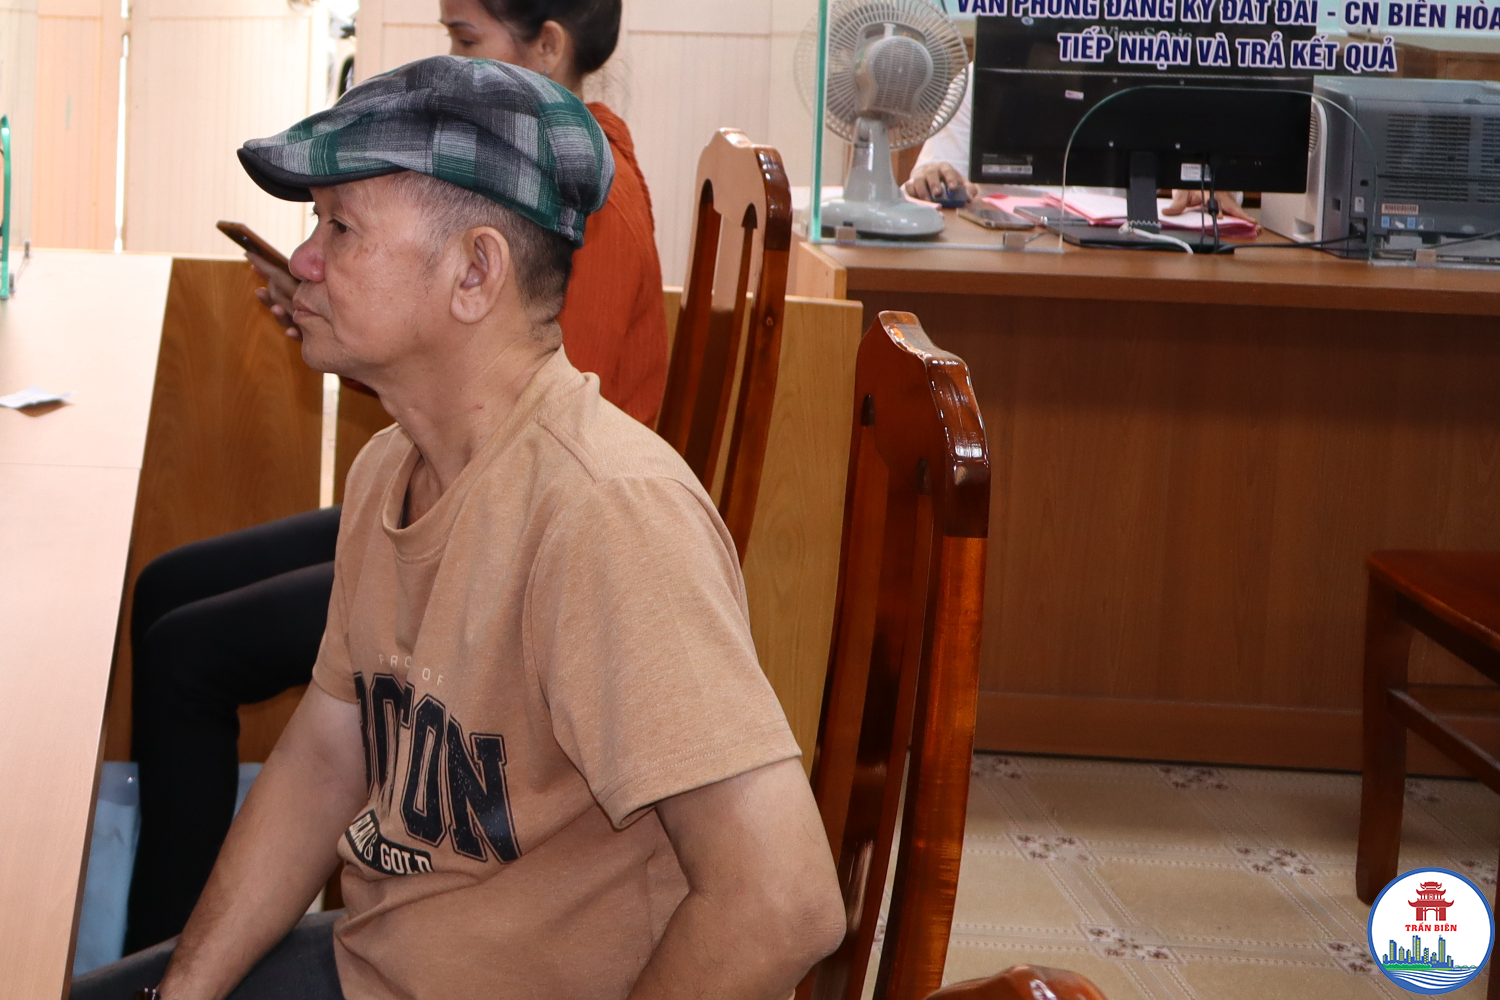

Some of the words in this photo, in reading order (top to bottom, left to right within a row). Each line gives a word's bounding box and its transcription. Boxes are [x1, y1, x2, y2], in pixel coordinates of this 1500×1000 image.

[1276, 0, 1318, 24] ĐAI
[1345, 1, 1379, 25] CN
[1059, 26, 1112, 60] TIẾP
[1120, 32, 1190, 68] NHẬN
[1197, 32, 1230, 66] VÀ
[1237, 33, 1284, 66] TRẢ
[1291, 36, 1340, 68] KẾT
[1345, 37, 1397, 73] QUẢ
